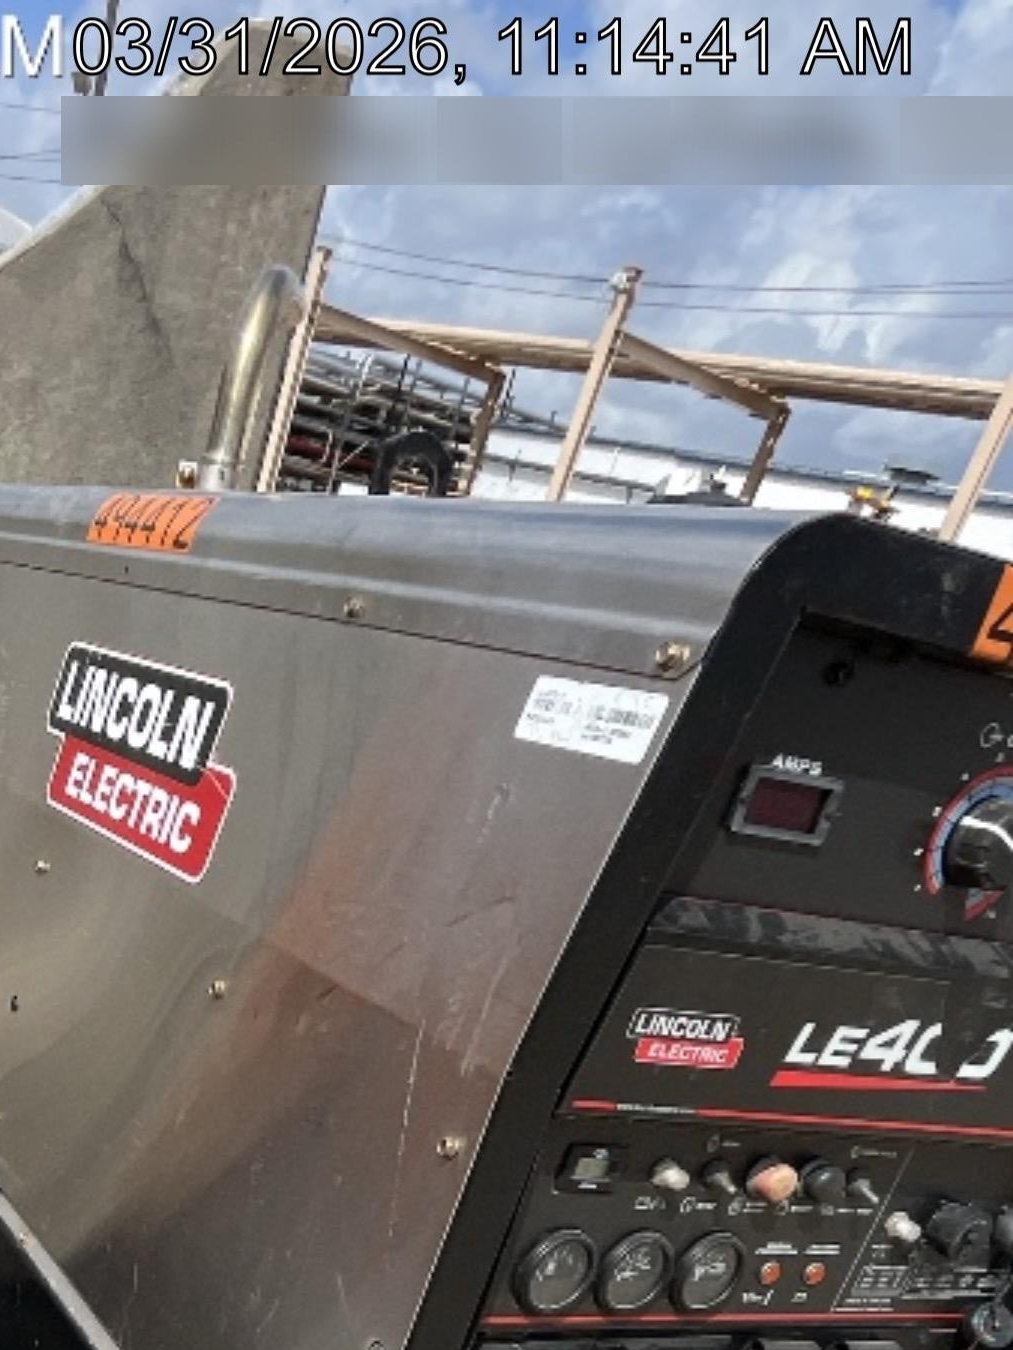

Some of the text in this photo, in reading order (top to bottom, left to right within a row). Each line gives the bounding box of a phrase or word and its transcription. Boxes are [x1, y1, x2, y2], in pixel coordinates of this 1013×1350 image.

[56, 659, 216, 771] LINCOLN
[771, 751, 823, 776] AMPS
[64, 752, 201, 854] ELECTRIC
[634, 1012, 732, 1042] LINCOLN
[648, 1042, 730, 1064] ELECTRIC
